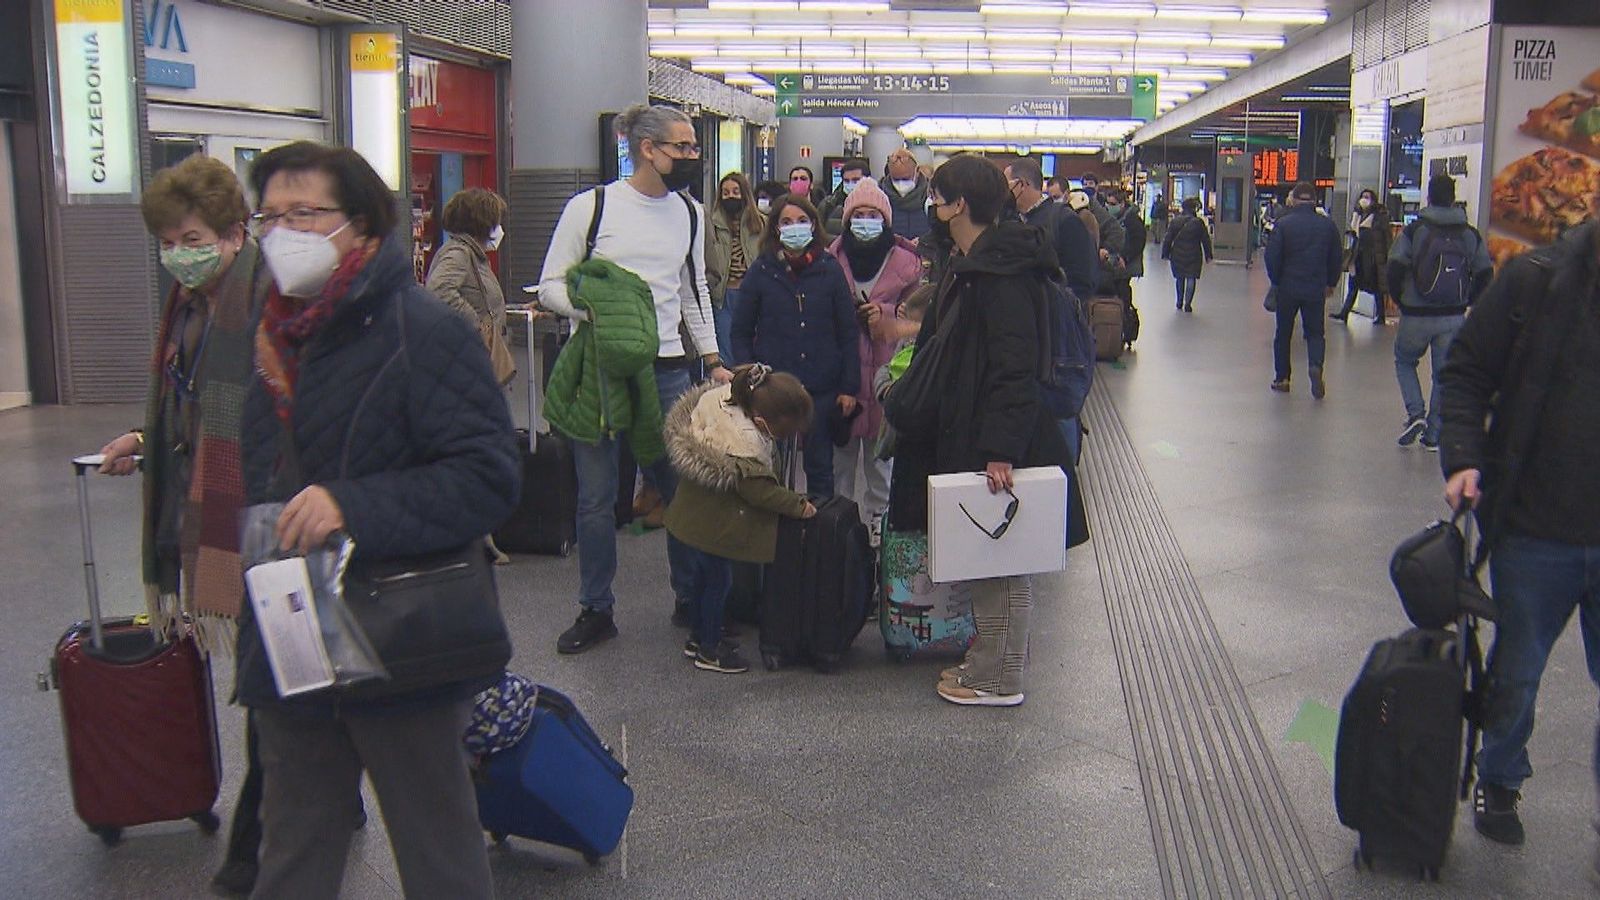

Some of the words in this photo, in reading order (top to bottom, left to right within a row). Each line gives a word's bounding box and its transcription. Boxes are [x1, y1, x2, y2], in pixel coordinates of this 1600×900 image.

[1514, 40, 1556, 59] PIZZA
[1513, 61, 1552, 80] TIME!
[818, 76, 851, 84] Llegadas
[1050, 77, 1078, 85] Salidas
[84, 31, 106, 183] CALZEDONIA
[803, 98, 825, 107] Salida
[826, 98, 855, 107] Méndez
[856, 97, 879, 107] Álvaro
